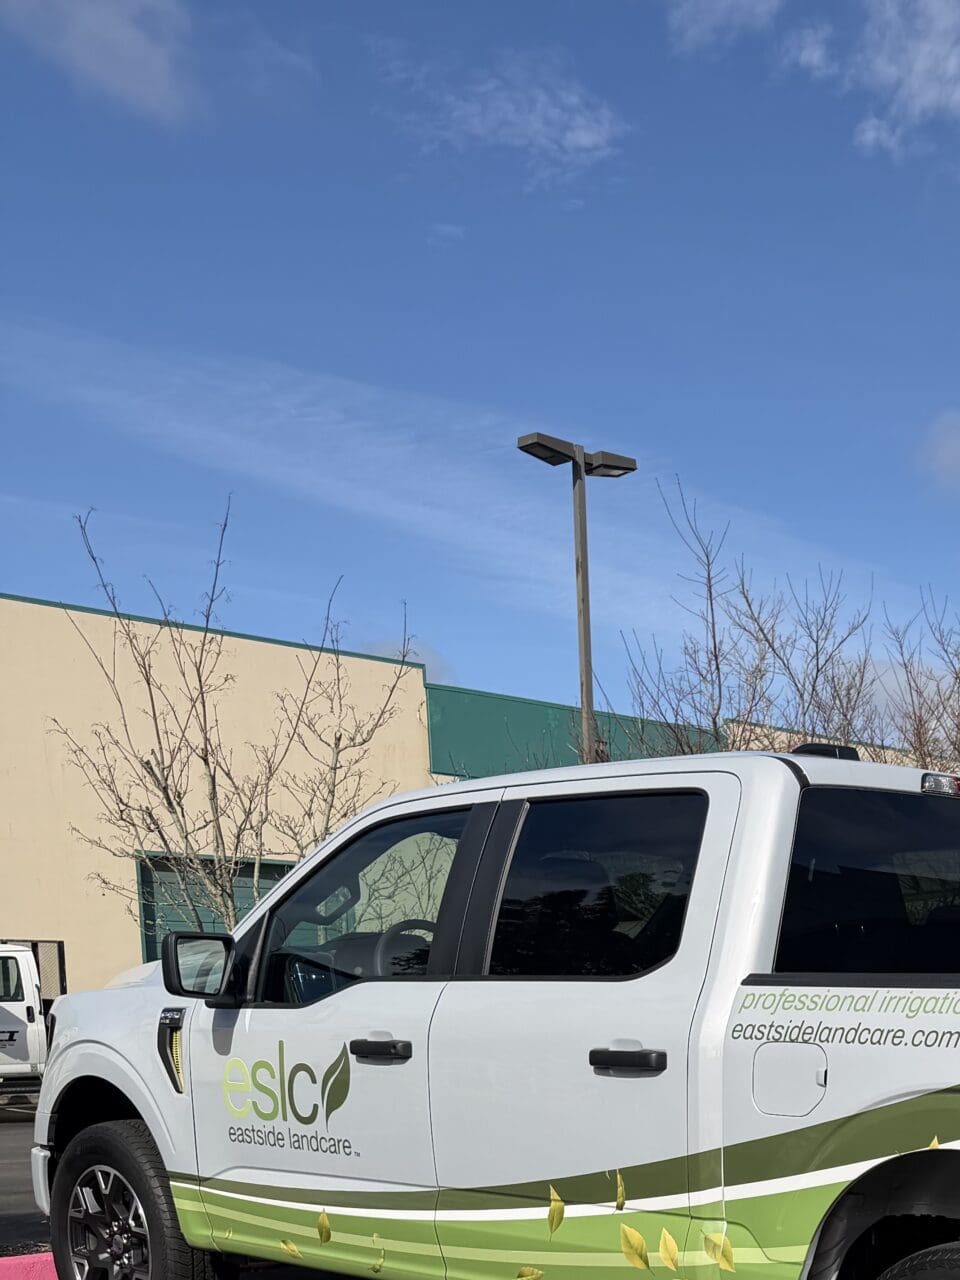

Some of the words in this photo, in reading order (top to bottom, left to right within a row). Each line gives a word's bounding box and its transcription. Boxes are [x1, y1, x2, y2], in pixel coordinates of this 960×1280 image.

[737, 987, 878, 1016] professional
[222, 1039, 319, 1126] eslc
[228, 1124, 286, 1149] eastside
[288, 1127, 353, 1157] landcare
